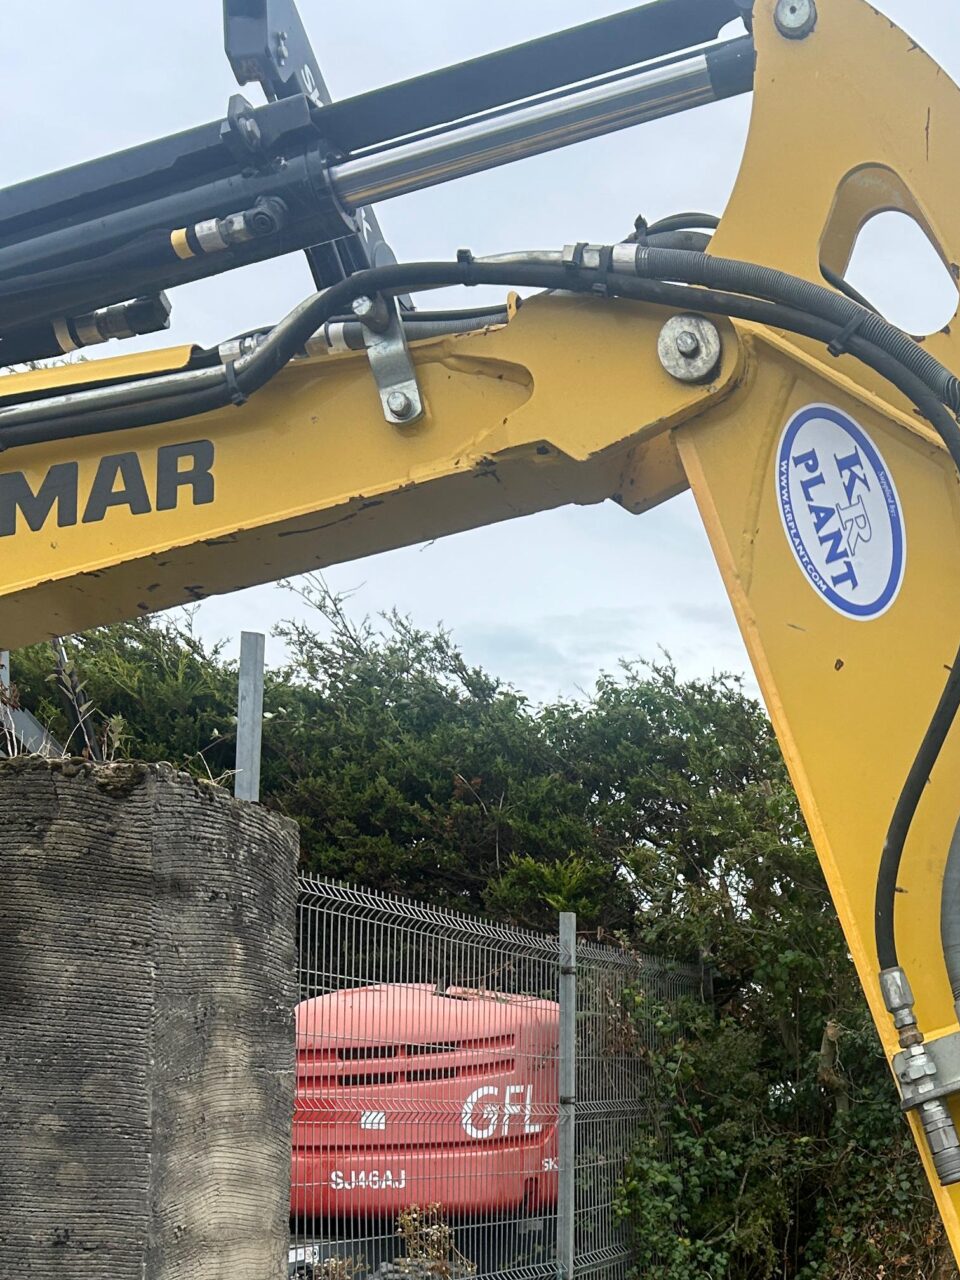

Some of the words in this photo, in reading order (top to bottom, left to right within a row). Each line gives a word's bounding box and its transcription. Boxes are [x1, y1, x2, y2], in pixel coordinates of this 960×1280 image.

[0, 439, 215, 537] MAR
[780, 459, 828, 592] WWW.KRPLANT.COM
[792, 448, 858, 590] PLANT
[833, 445, 873, 556] KR
